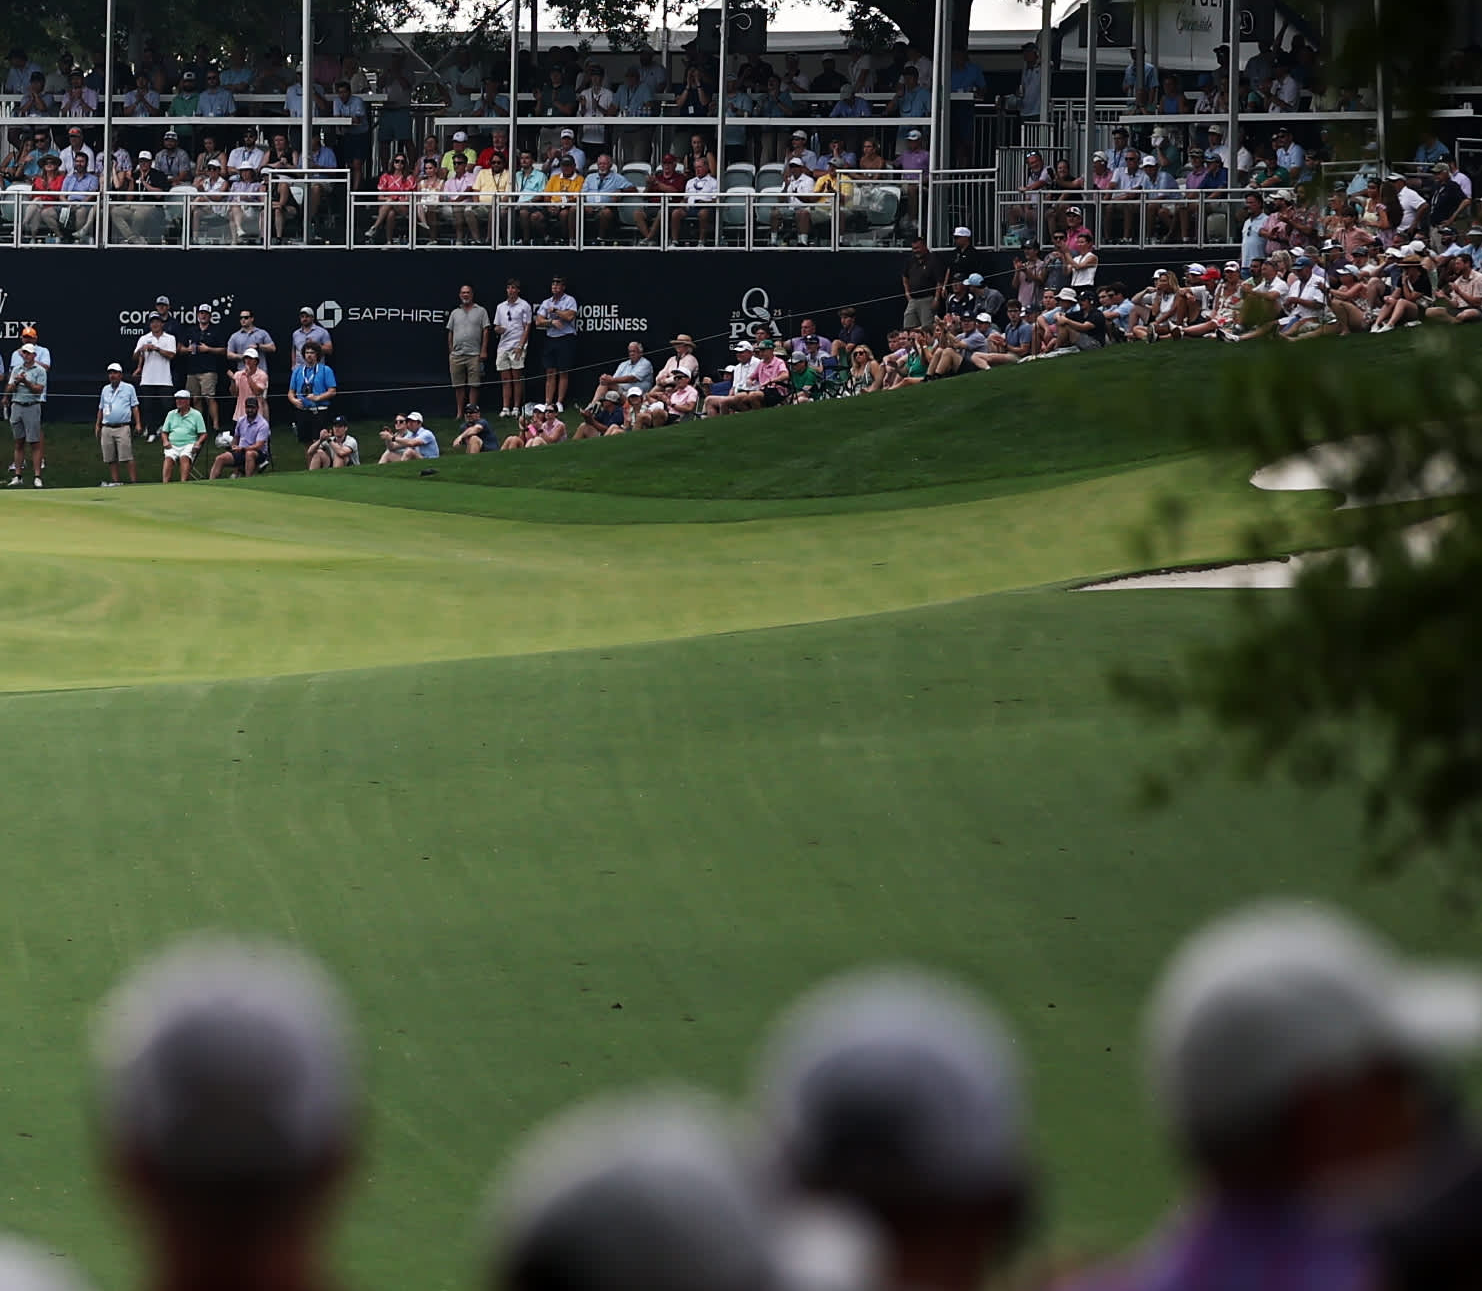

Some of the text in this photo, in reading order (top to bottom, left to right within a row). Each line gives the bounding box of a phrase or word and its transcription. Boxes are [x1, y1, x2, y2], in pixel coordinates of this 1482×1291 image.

[119, 306, 221, 324] corride
[348, 307, 444, 323] SAPPHIRE
[120, 326, 144, 335] finan
[586, 318, 648, 331] BUSINESS
